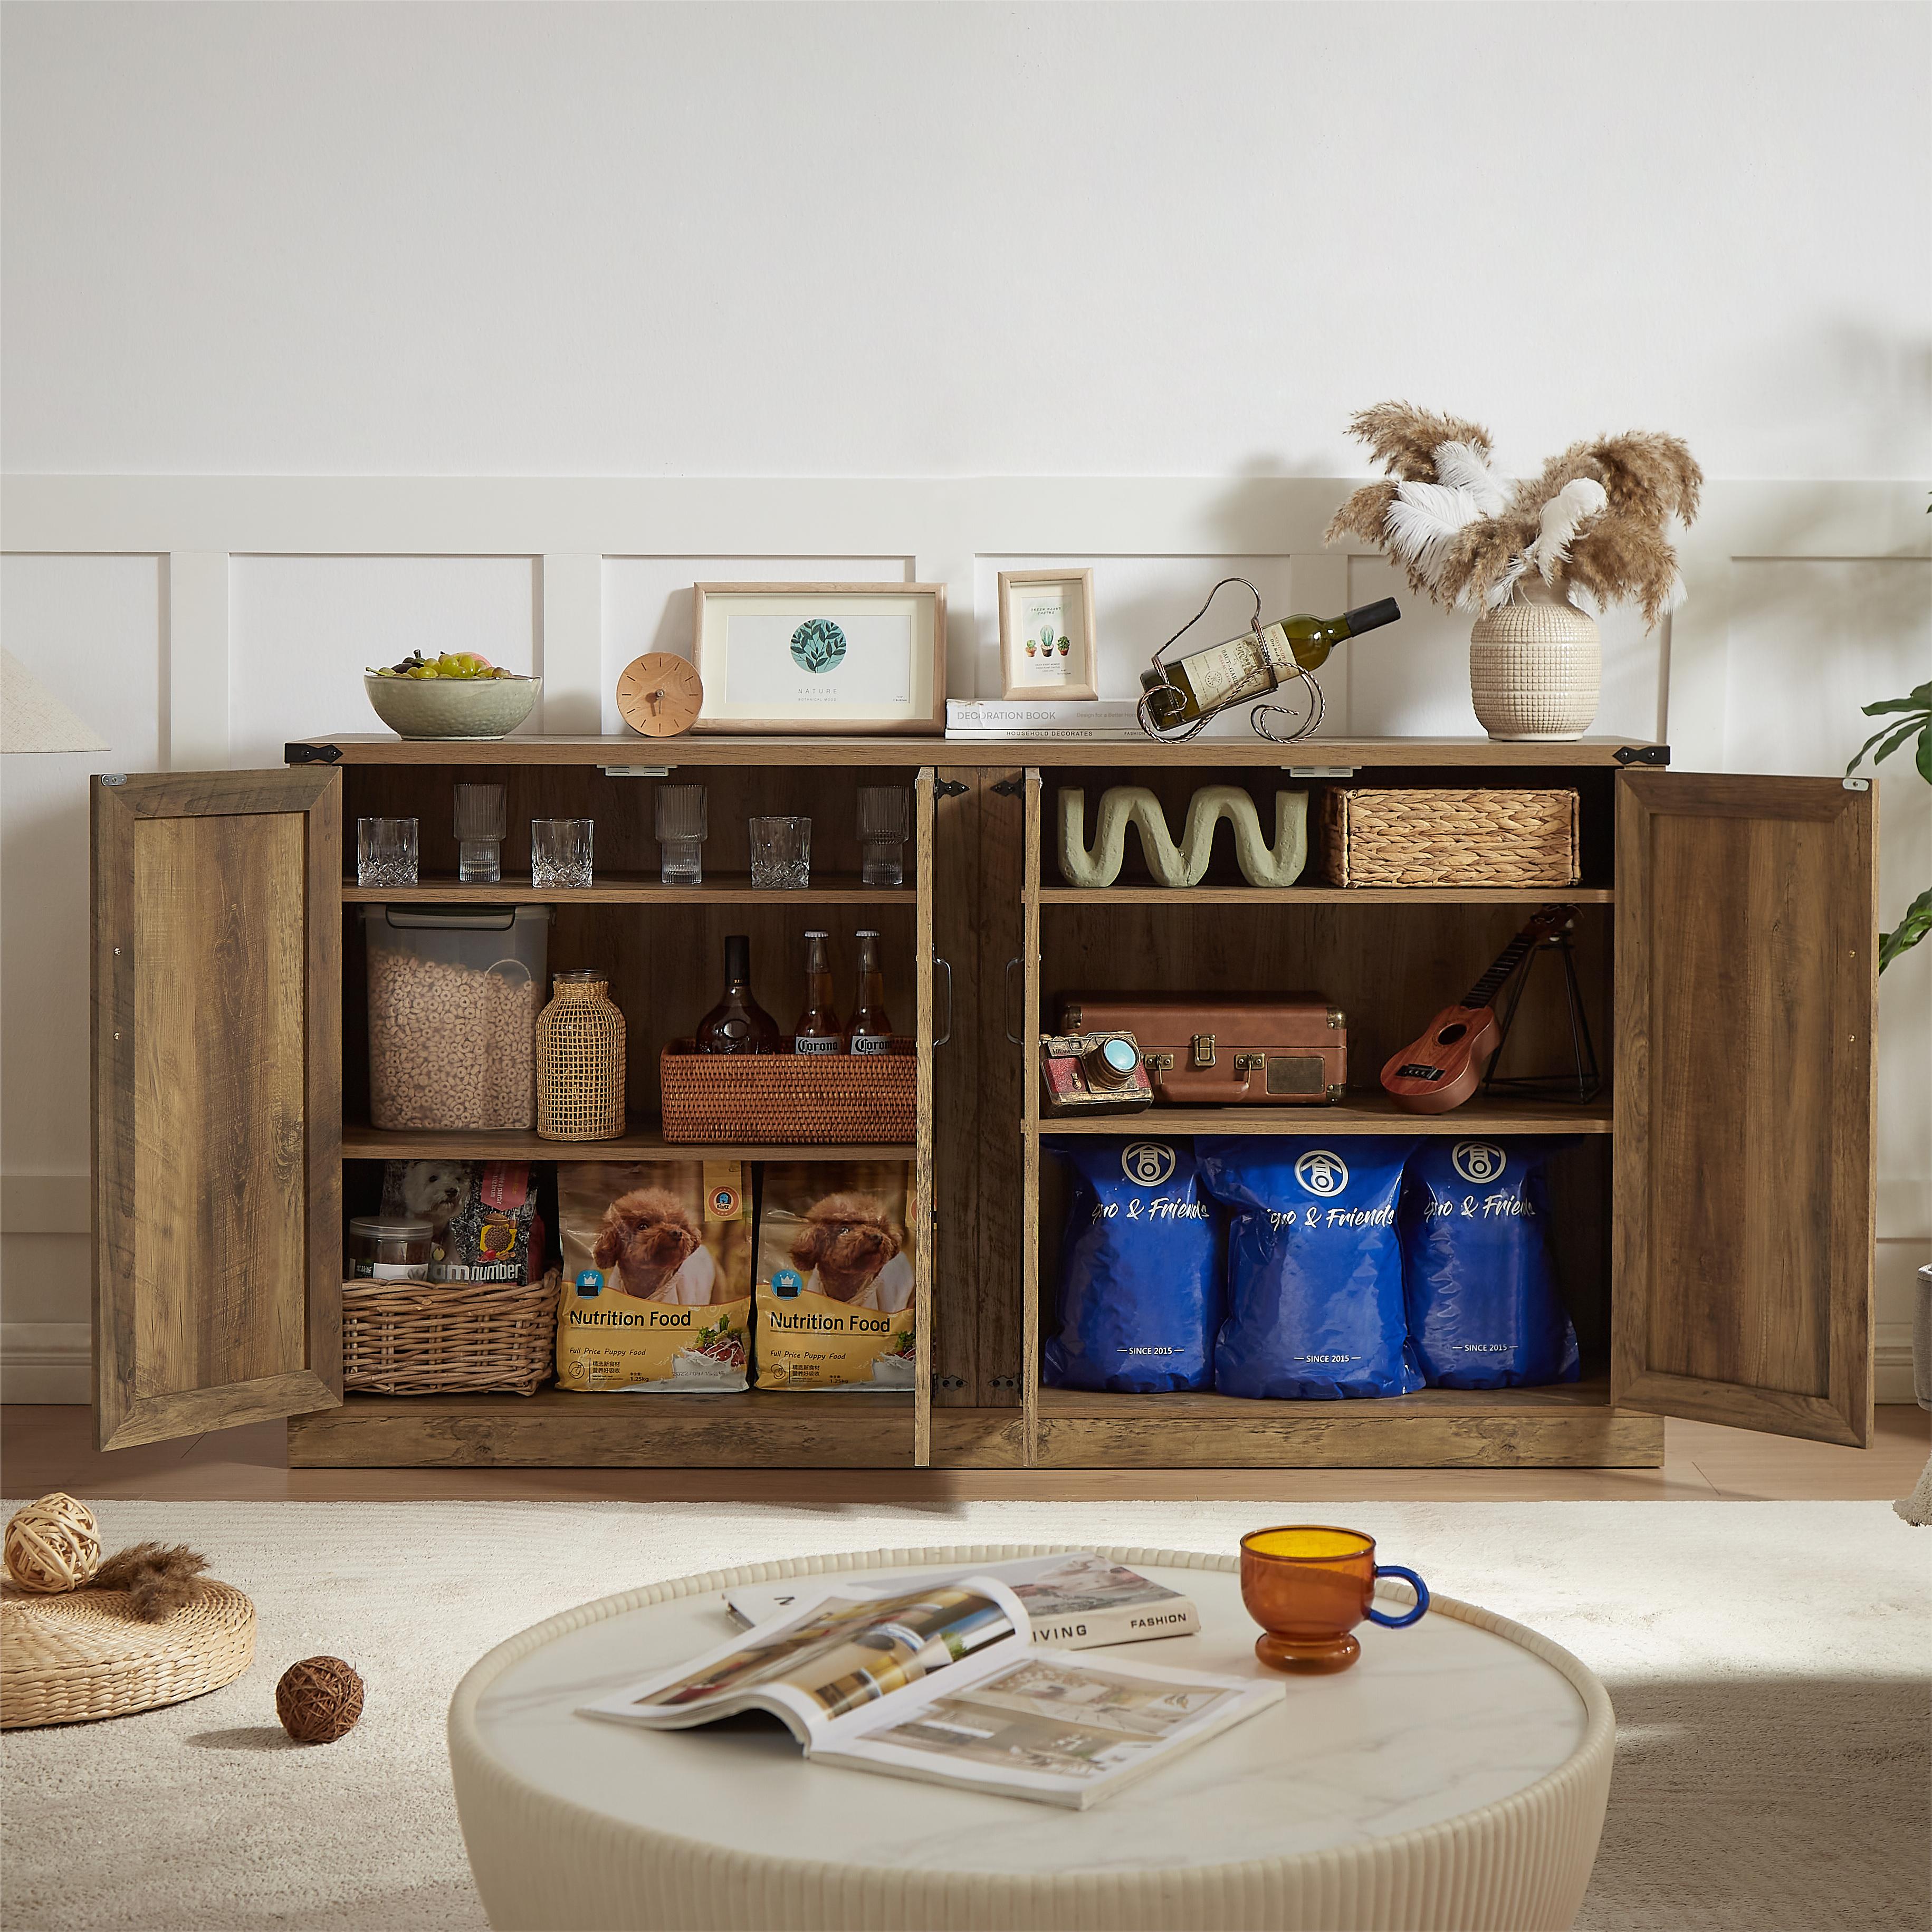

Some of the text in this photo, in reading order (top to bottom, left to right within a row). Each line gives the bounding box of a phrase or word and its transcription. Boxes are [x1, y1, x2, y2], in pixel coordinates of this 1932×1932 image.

[798, 1039, 838, 1053] Corona
[1126, 1198, 1145, 1220] &
[1304, 1207, 1323, 1228] &
[1326, 1203, 1395, 1229] Friends
[1461, 1195, 1479, 1218] &
[433, 1263, 521, 1281] am number
[570, 1311, 691, 1326] Nutrition Food
[770, 1312, 891, 1333] Nutrition Food
[804, 1352, 826, 1360] Puppy
[1032, 1613, 1187, 1642] IVING FASHION
